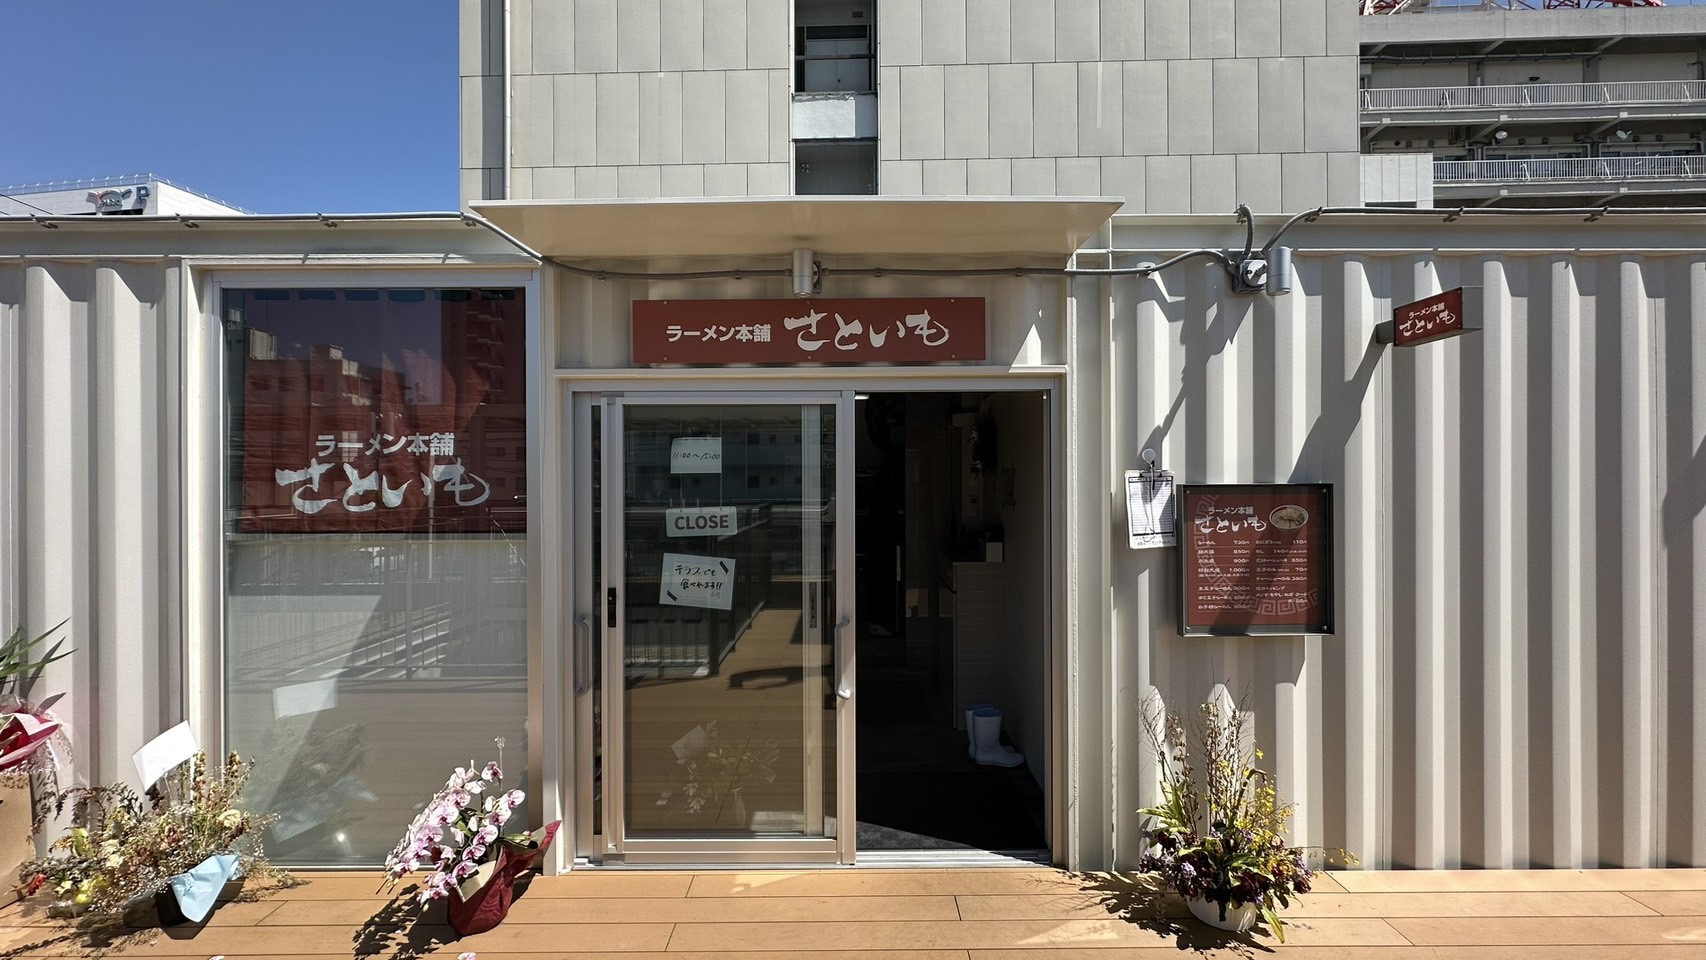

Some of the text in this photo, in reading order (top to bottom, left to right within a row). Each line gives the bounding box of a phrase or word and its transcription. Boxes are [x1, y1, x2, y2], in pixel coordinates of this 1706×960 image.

[136, 186, 150, 204] P
[666, 308, 950, 351] ラーメン本舗 さといも
[1399, 309, 1456, 337] さといも
[315, 432, 455, 456] ラーメン本舗
[275, 457, 490, 514] さといも
[674, 514, 730, 530] CLOSE
[1194, 515, 1267, 533] さといも
